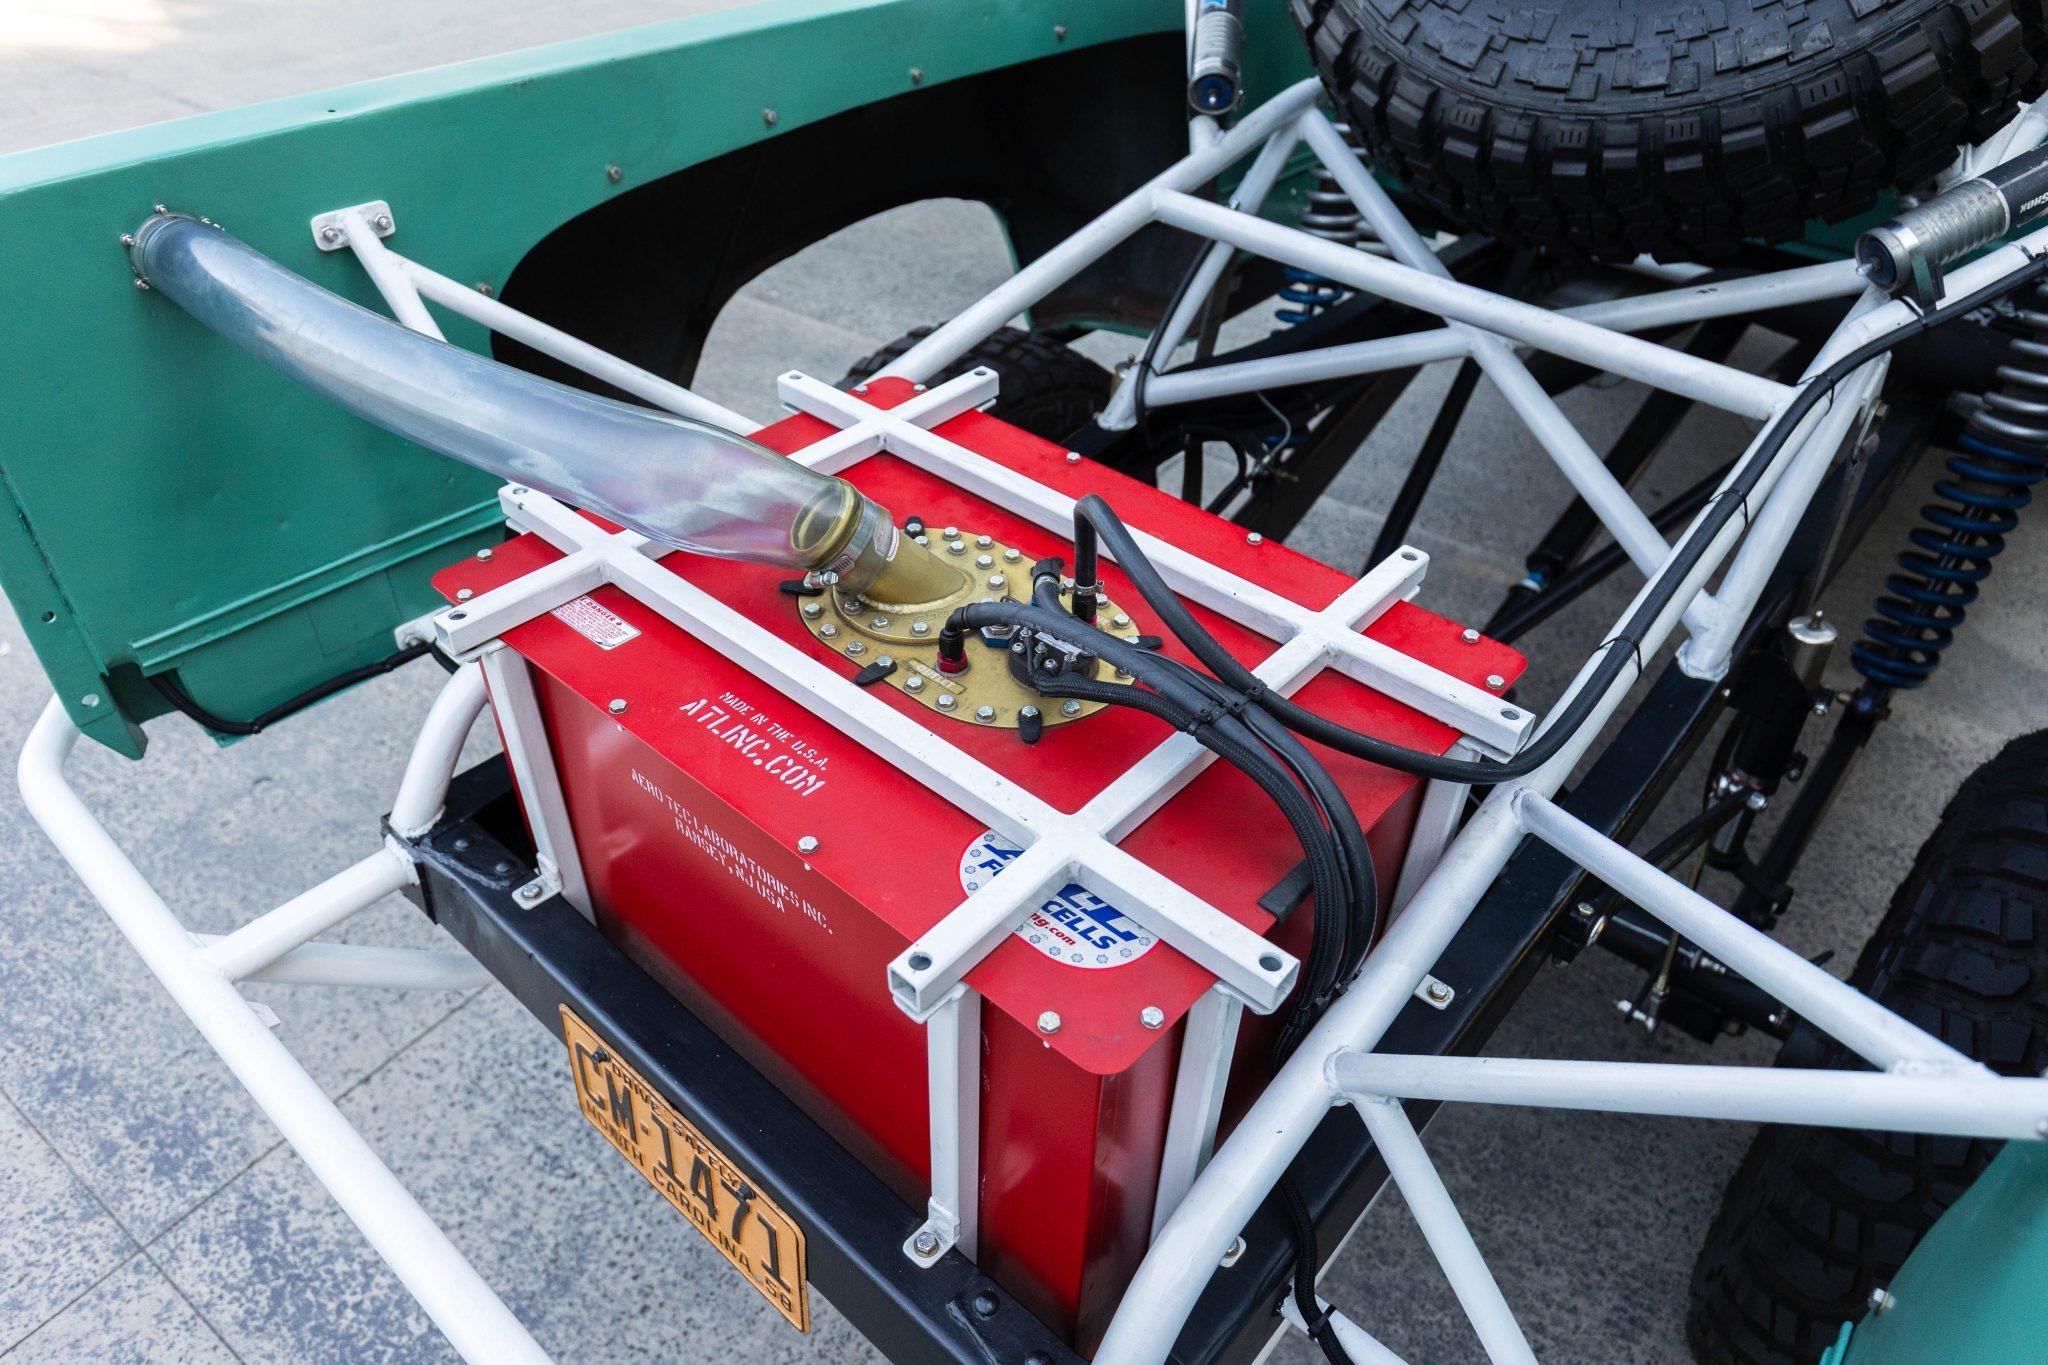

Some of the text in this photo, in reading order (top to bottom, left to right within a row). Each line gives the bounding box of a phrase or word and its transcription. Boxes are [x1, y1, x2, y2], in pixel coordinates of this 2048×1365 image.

[679, 698, 826, 797] ATLINC.COM
[718, 691, 829, 771] MADE IN THE U.S.A.
[631, 768, 833, 934] AERO TEC LABORATORIES INC.
[756, 880, 785, 913] USA
[1030, 912, 1077, 946] ng.com
[1041, 900, 1118, 949] CELLS
[575, 1041, 791, 1294] CM-1471
[612, 1062, 739, 1188] DRIVE SAFELY
[583, 1098, 793, 1313] NORTH CAROLINA 58
